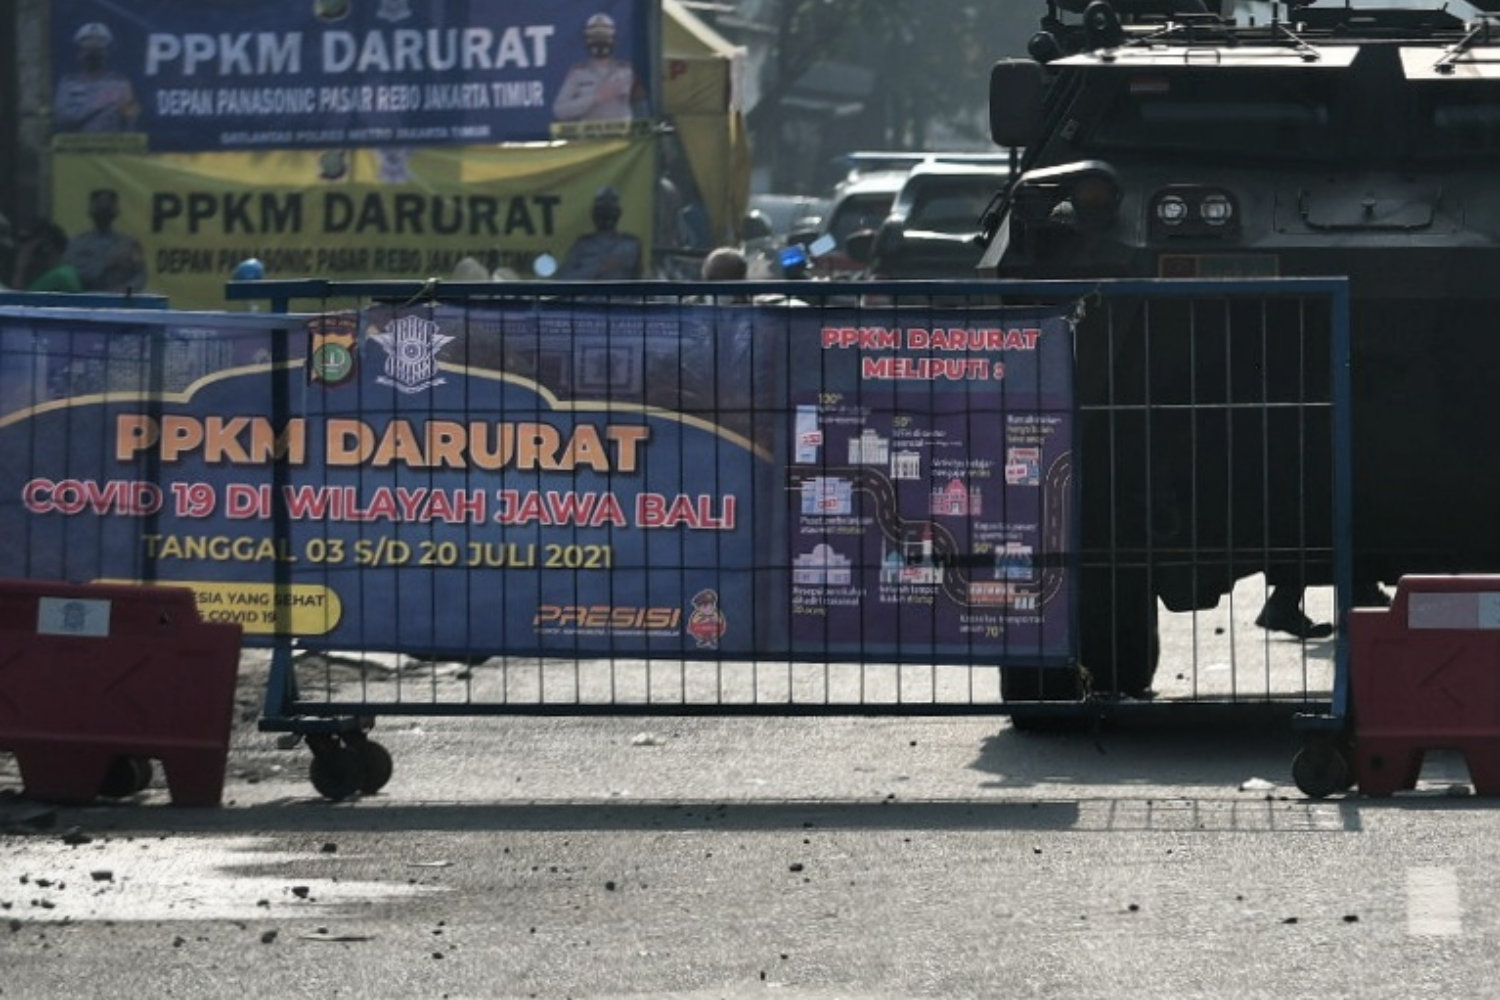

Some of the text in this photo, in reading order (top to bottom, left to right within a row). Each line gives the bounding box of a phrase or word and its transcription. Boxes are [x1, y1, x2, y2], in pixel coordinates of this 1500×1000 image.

[145, 24, 556, 76] PPKM DARURAT
[156, 81, 545, 115] DEPAN PANASONIC PASAR REBO JAKARTA TIMUR
[150, 193, 562, 238] PPKM DARURAT
[157, 248, 215, 273] DEPAN
[822, 327, 1041, 350] PPKM DARURAT
[862, 357, 989, 380] MELIPUTI
[116, 413, 650, 473] PPKM DARURAT
[22, 478, 737, 530] COVID 19 DI WILAYAH JAWA BALI
[141, 533, 613, 569] TANGGAL 03 S/D 20 JULI 2021
[228, 592, 270, 606] YANG
[208, 609, 258, 623] COVID
[533, 604, 682, 628] PRESISI
